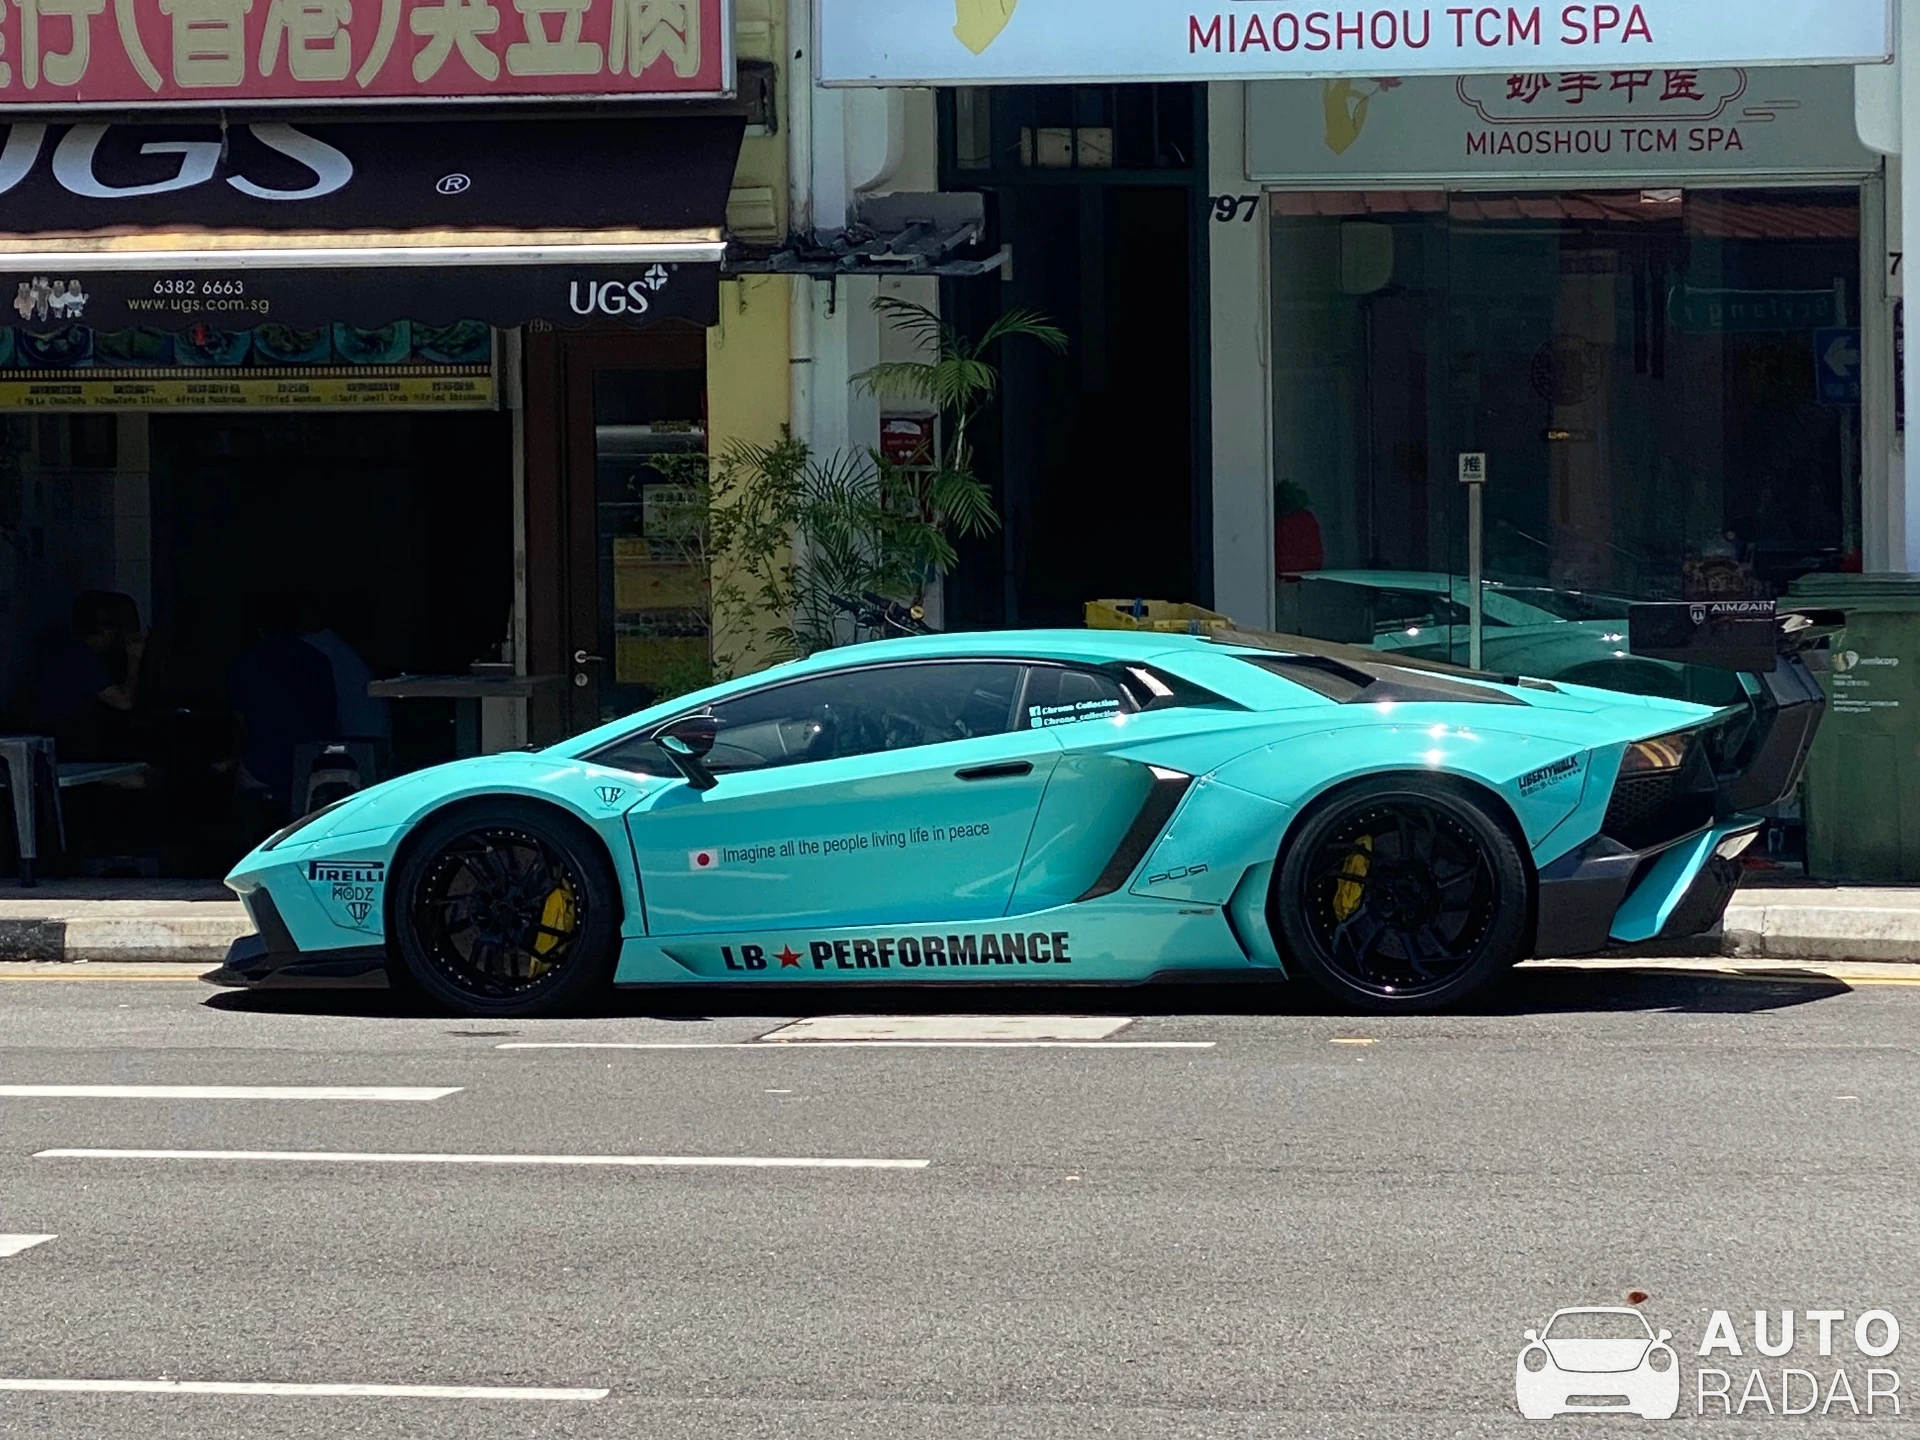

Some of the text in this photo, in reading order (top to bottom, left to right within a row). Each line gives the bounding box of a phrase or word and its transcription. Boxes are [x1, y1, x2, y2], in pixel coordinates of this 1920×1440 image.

[1188, 4, 1653, 53] MIAOSHOU TCM SPA
[1506, 69, 1705, 103] 妙手中医
[1466, 127, 1743, 154] MIAOSHOU TCM SPA
[154, 280, 243, 294] 6382 6663
[570, 281, 648, 314] UGS
[128, 299, 269, 313] www.ugs.com.sg
[1076, 699, 1119, 709] Collection
[723, 822, 990, 864] Imagine all the people living life in peace
[308, 860, 384, 882] PIRELLI
[720, 932, 1072, 971] LB PERFORMANCE
